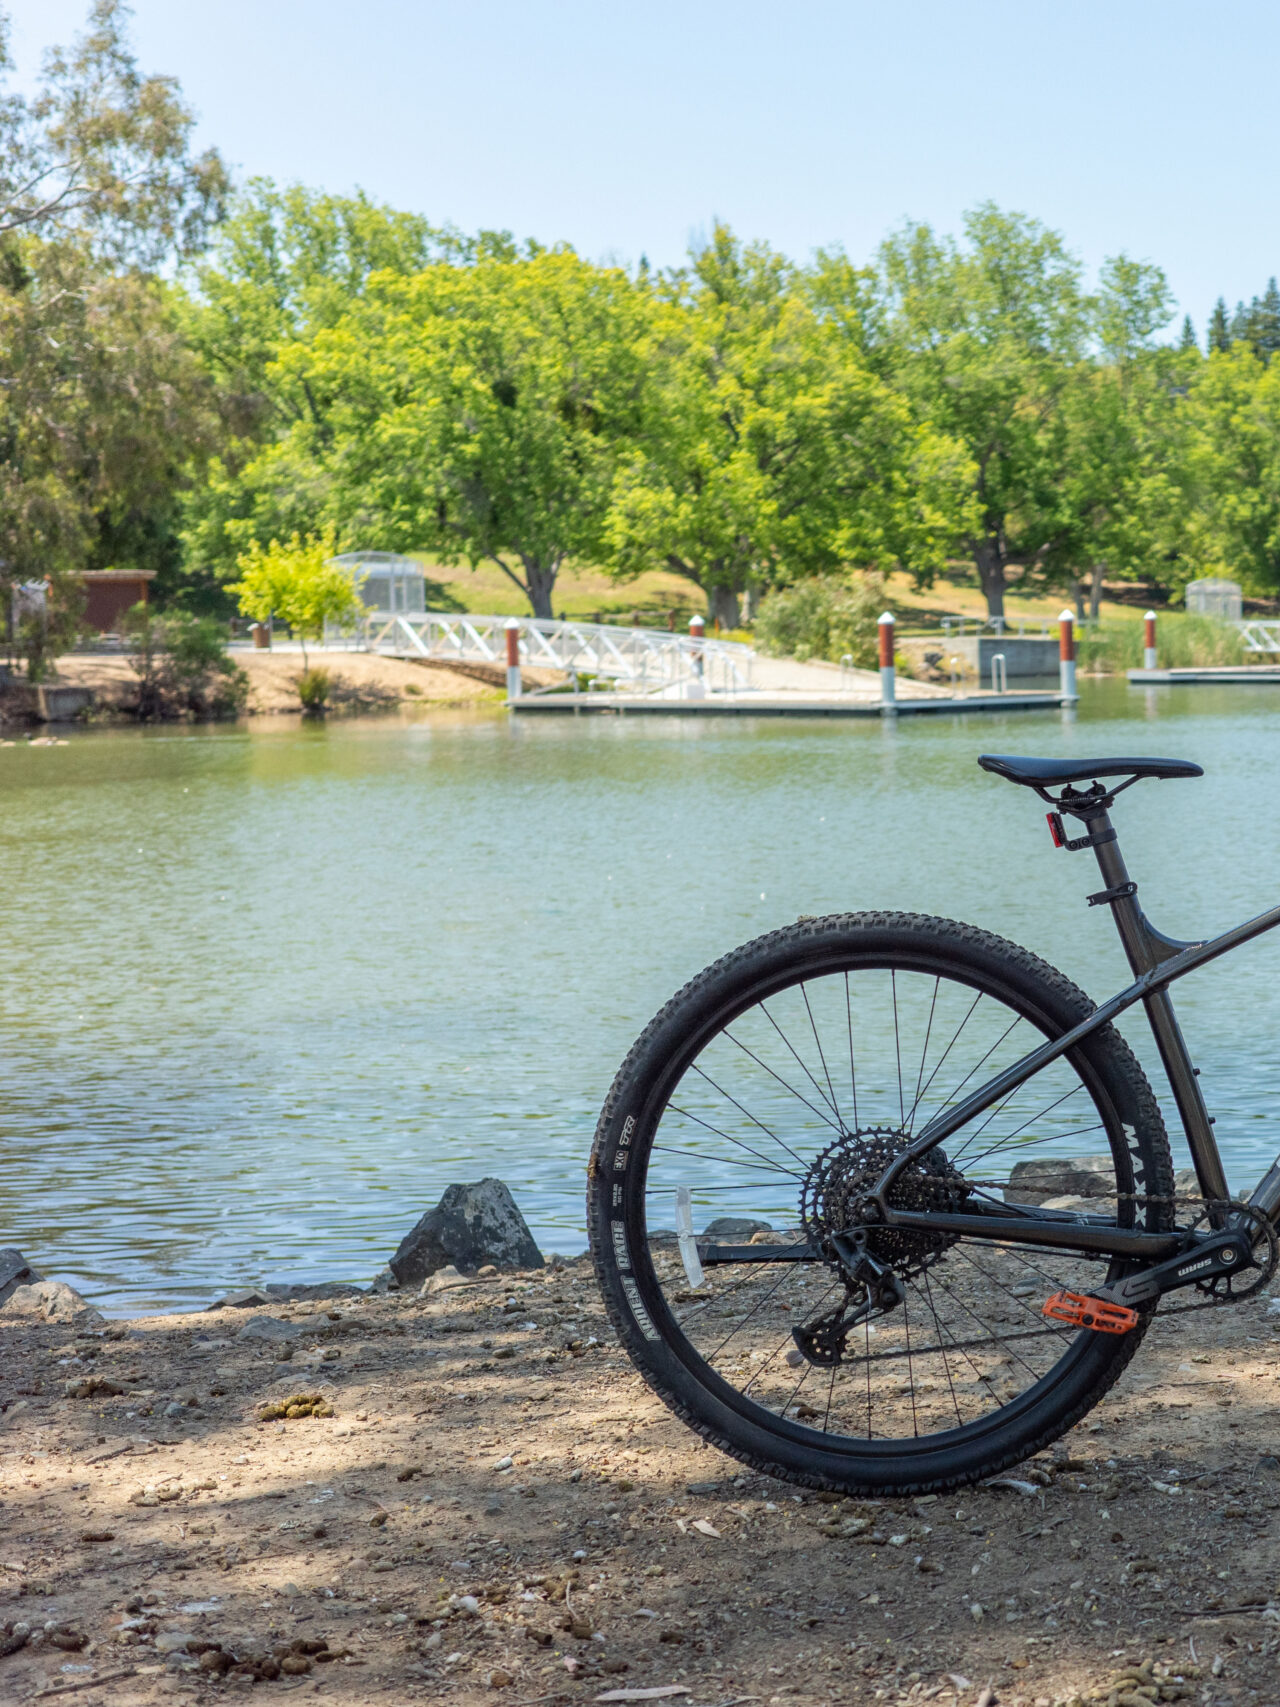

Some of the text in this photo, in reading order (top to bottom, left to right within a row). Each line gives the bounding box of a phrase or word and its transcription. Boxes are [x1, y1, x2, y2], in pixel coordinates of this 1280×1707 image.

[613, 1150, 627, 1171] EXO
[1121, 1122, 1147, 1228] MAXX
[611, 1219, 662, 1341] ARDENT RACE
[1178, 1257, 1212, 1277] SRAM
